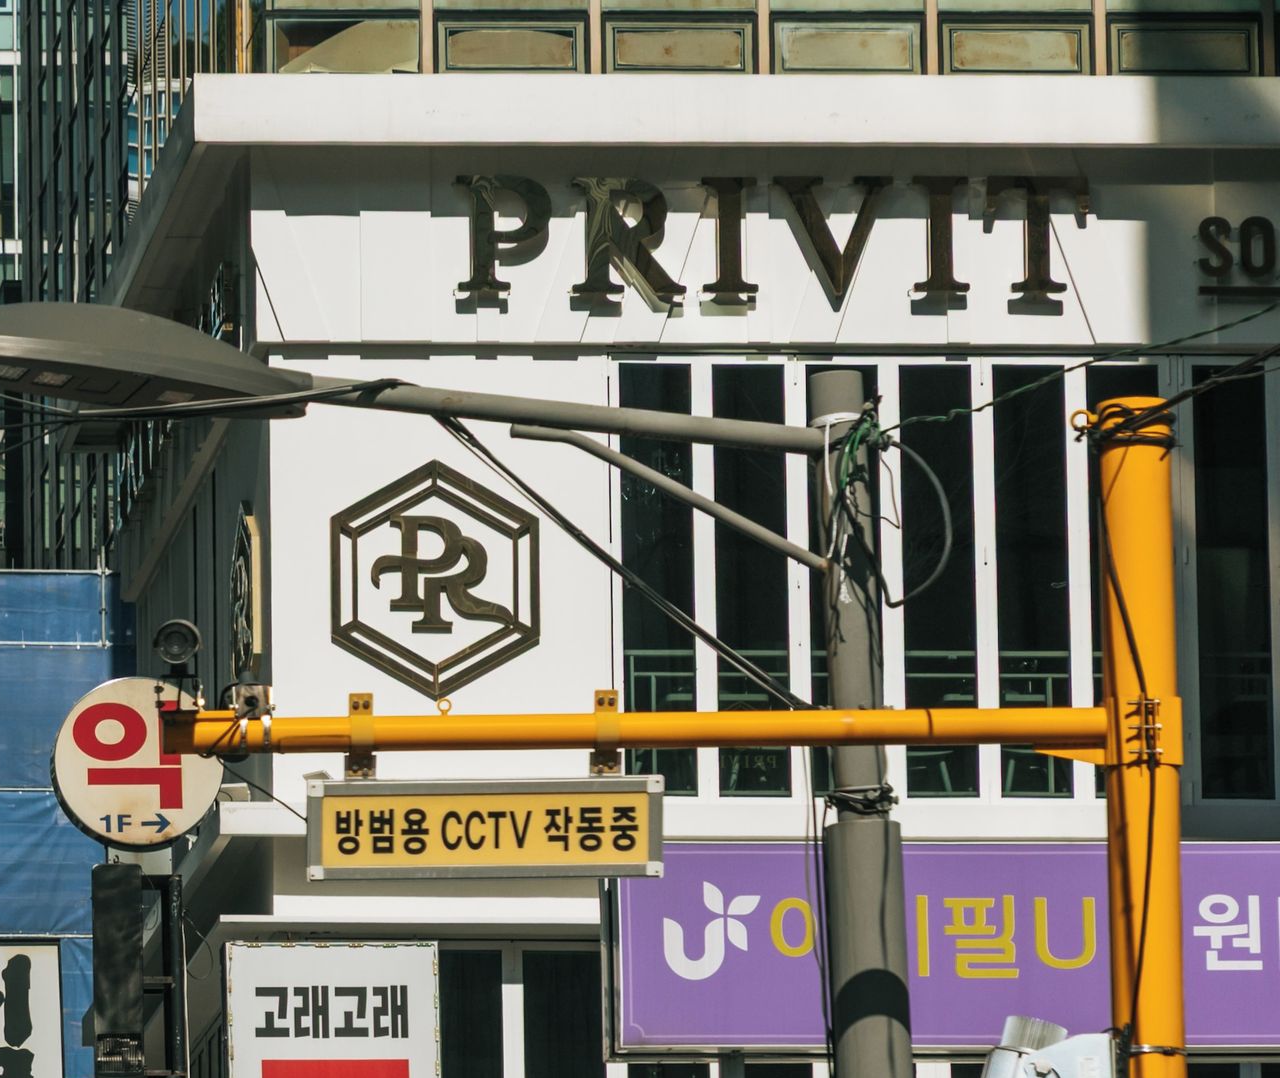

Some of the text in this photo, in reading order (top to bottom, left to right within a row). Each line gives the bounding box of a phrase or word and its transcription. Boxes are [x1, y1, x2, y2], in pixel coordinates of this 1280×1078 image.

[455, 174, 1089, 314] PRIVIT
[72, 700, 183, 809] 약
[100, 814, 132, 833] 1F
[334, 806, 639, 857] 방범용 CCTV 작동중
[770, 894, 1097, 979] 필U
[255, 985, 409, 1039] 고래고래
